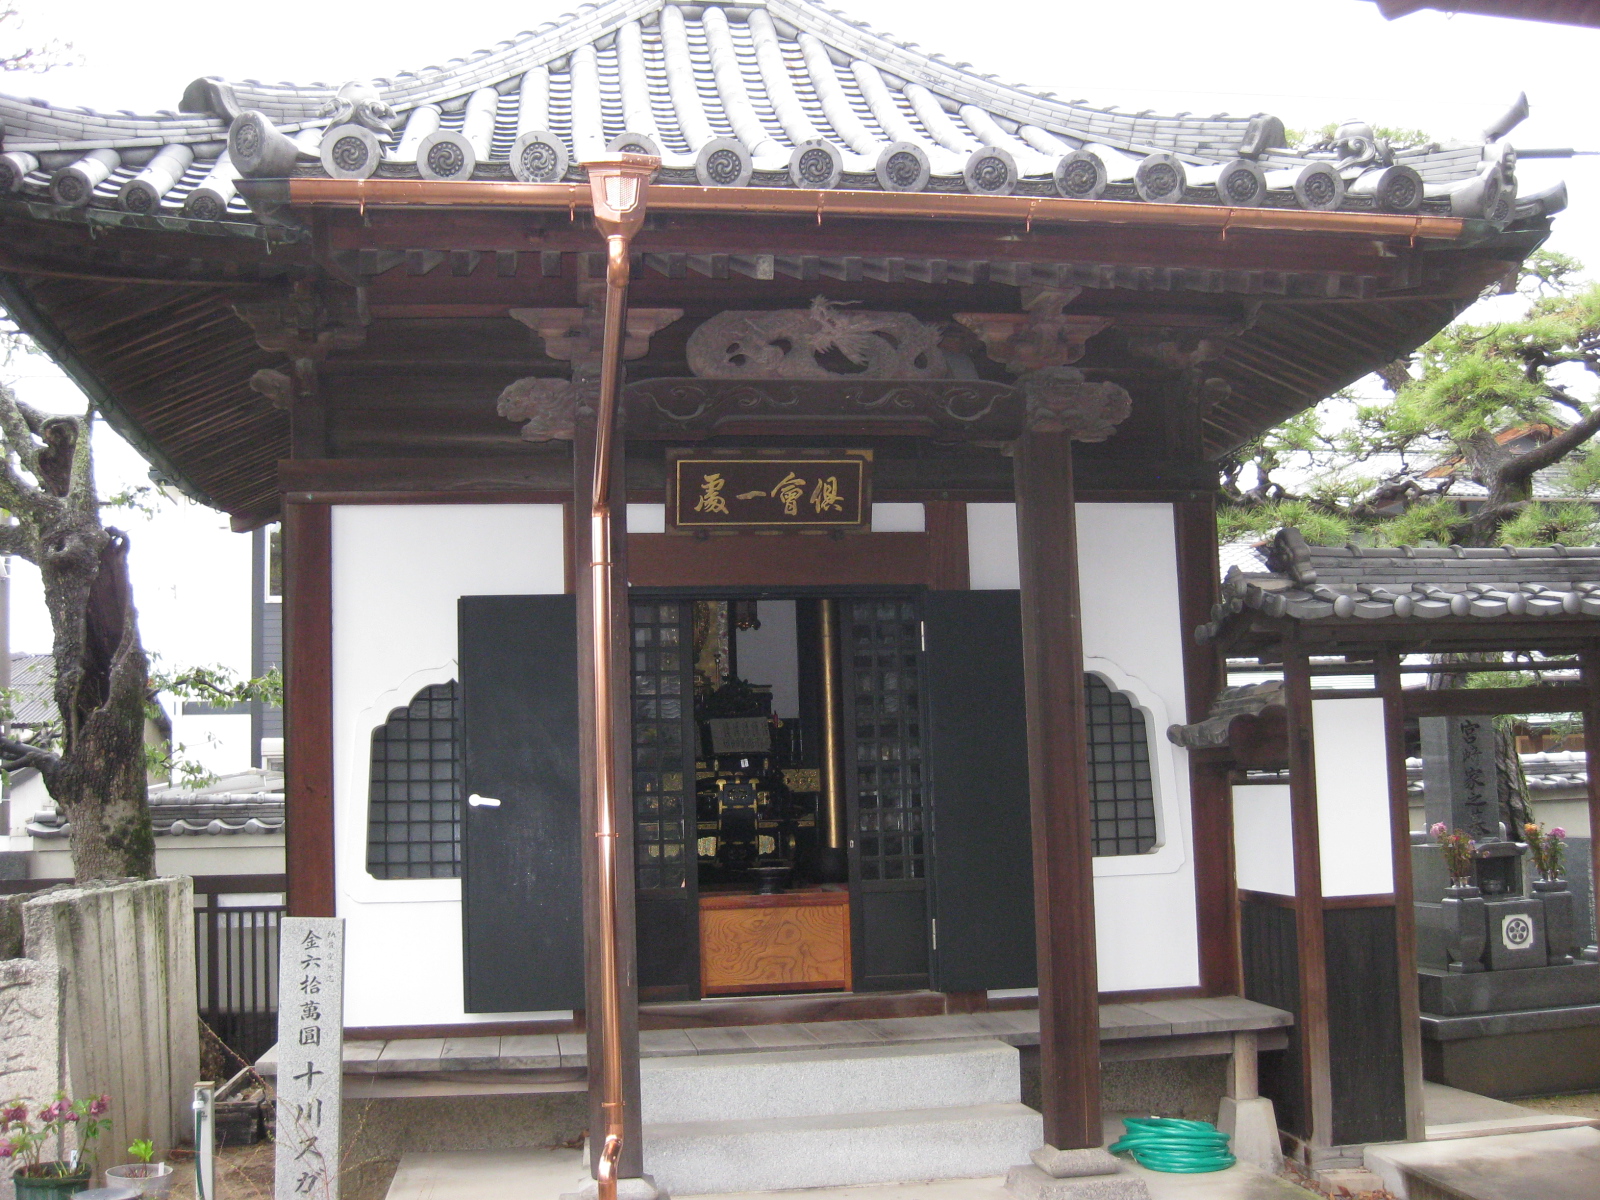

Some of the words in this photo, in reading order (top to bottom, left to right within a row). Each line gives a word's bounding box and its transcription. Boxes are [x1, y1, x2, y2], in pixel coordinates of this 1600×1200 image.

[299, 929, 322, 1047] 金六拾萬圓
